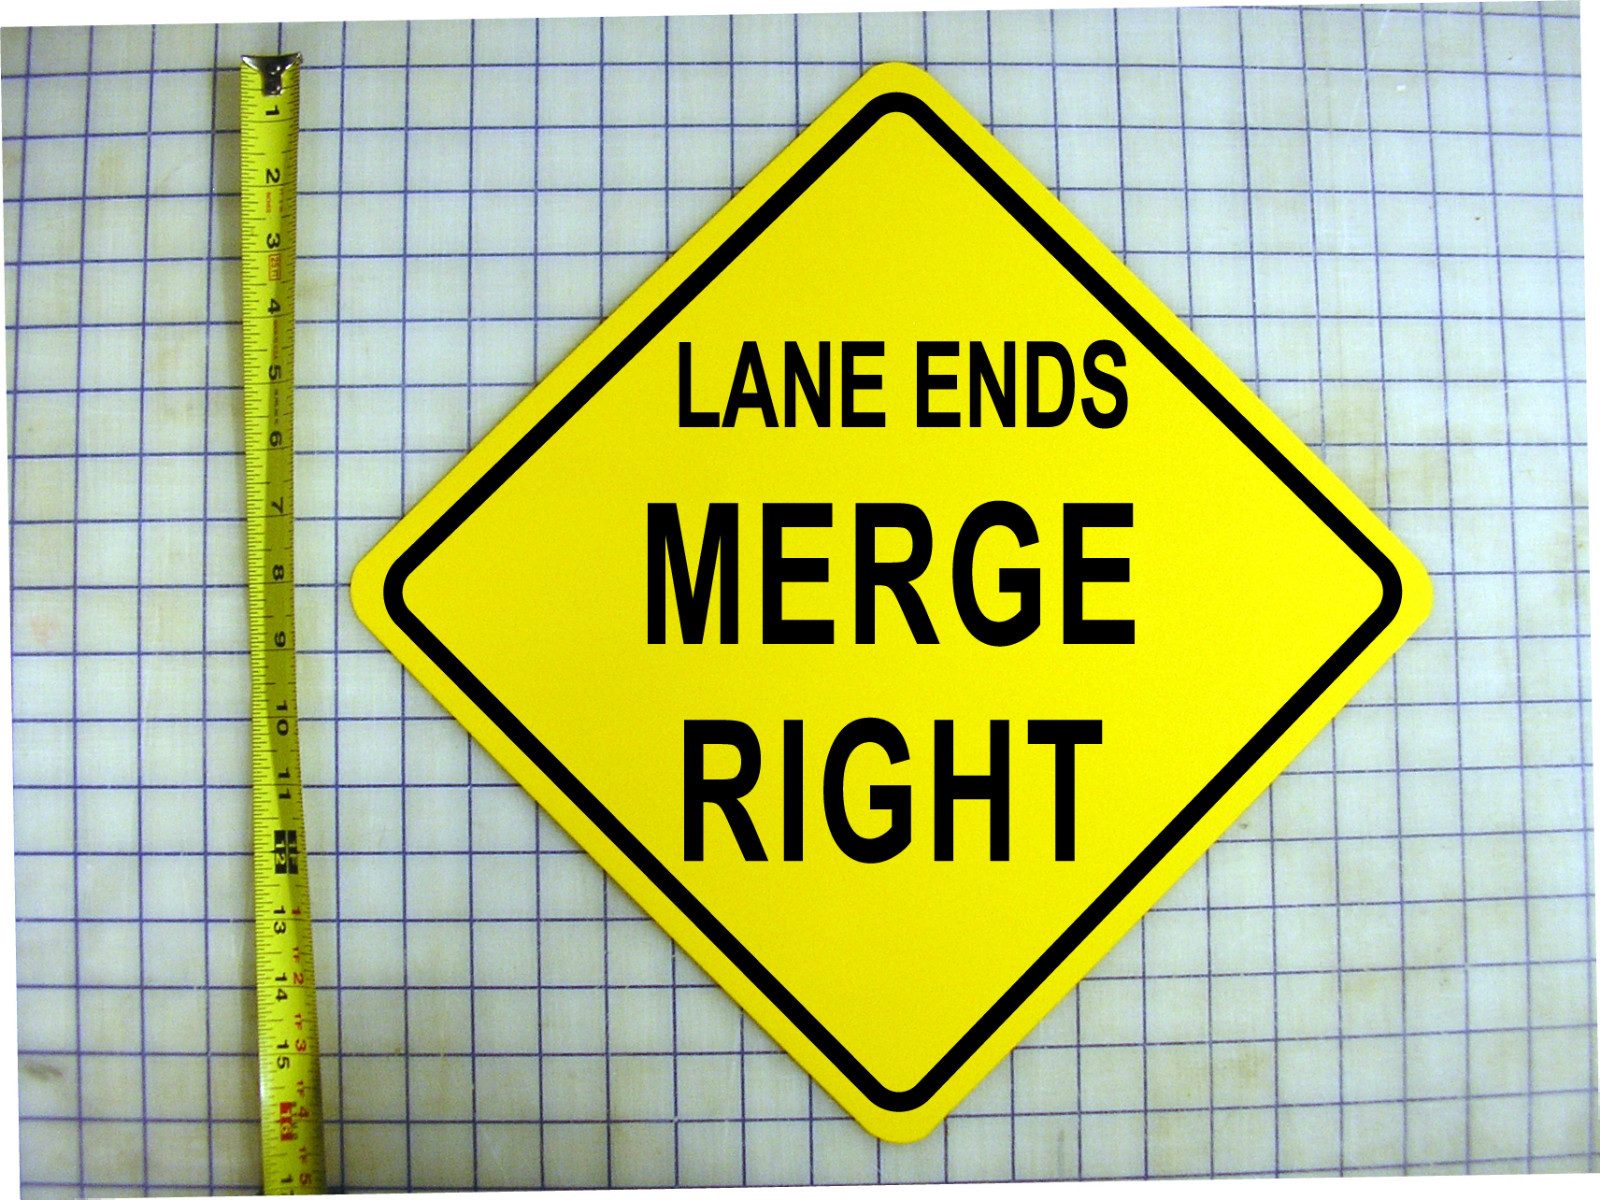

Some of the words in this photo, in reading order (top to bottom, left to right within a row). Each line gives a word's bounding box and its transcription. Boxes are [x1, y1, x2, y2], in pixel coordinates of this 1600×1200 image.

[265, 105, 280, 116] 1
[266, 168, 281, 184] 2
[266, 233, 281, 249] 3
[267, 299, 281, 314] 4
[268, 365, 282, 381] 5
[679, 341, 885, 427] LANE
[917, 340, 1128, 428] ENDS
[269, 431, 282, 447] 6
[271, 497, 284, 514] 7
[272, 564, 285, 581] 8
[648, 501, 1135, 646] MERGE
[274, 630, 287, 648] 9
[276, 700, 289, 736] 10
[278, 767, 291, 799] 11
[684, 718, 1102, 863] RIGHT
[275, 840, 286, 865] 12
[273, 905, 287, 934] 13
[275, 972, 288, 1002] 14
[293, 972, 304, 985] 2
[295, 1039, 307, 1052] 3
[276, 1040, 290, 1069] 15
